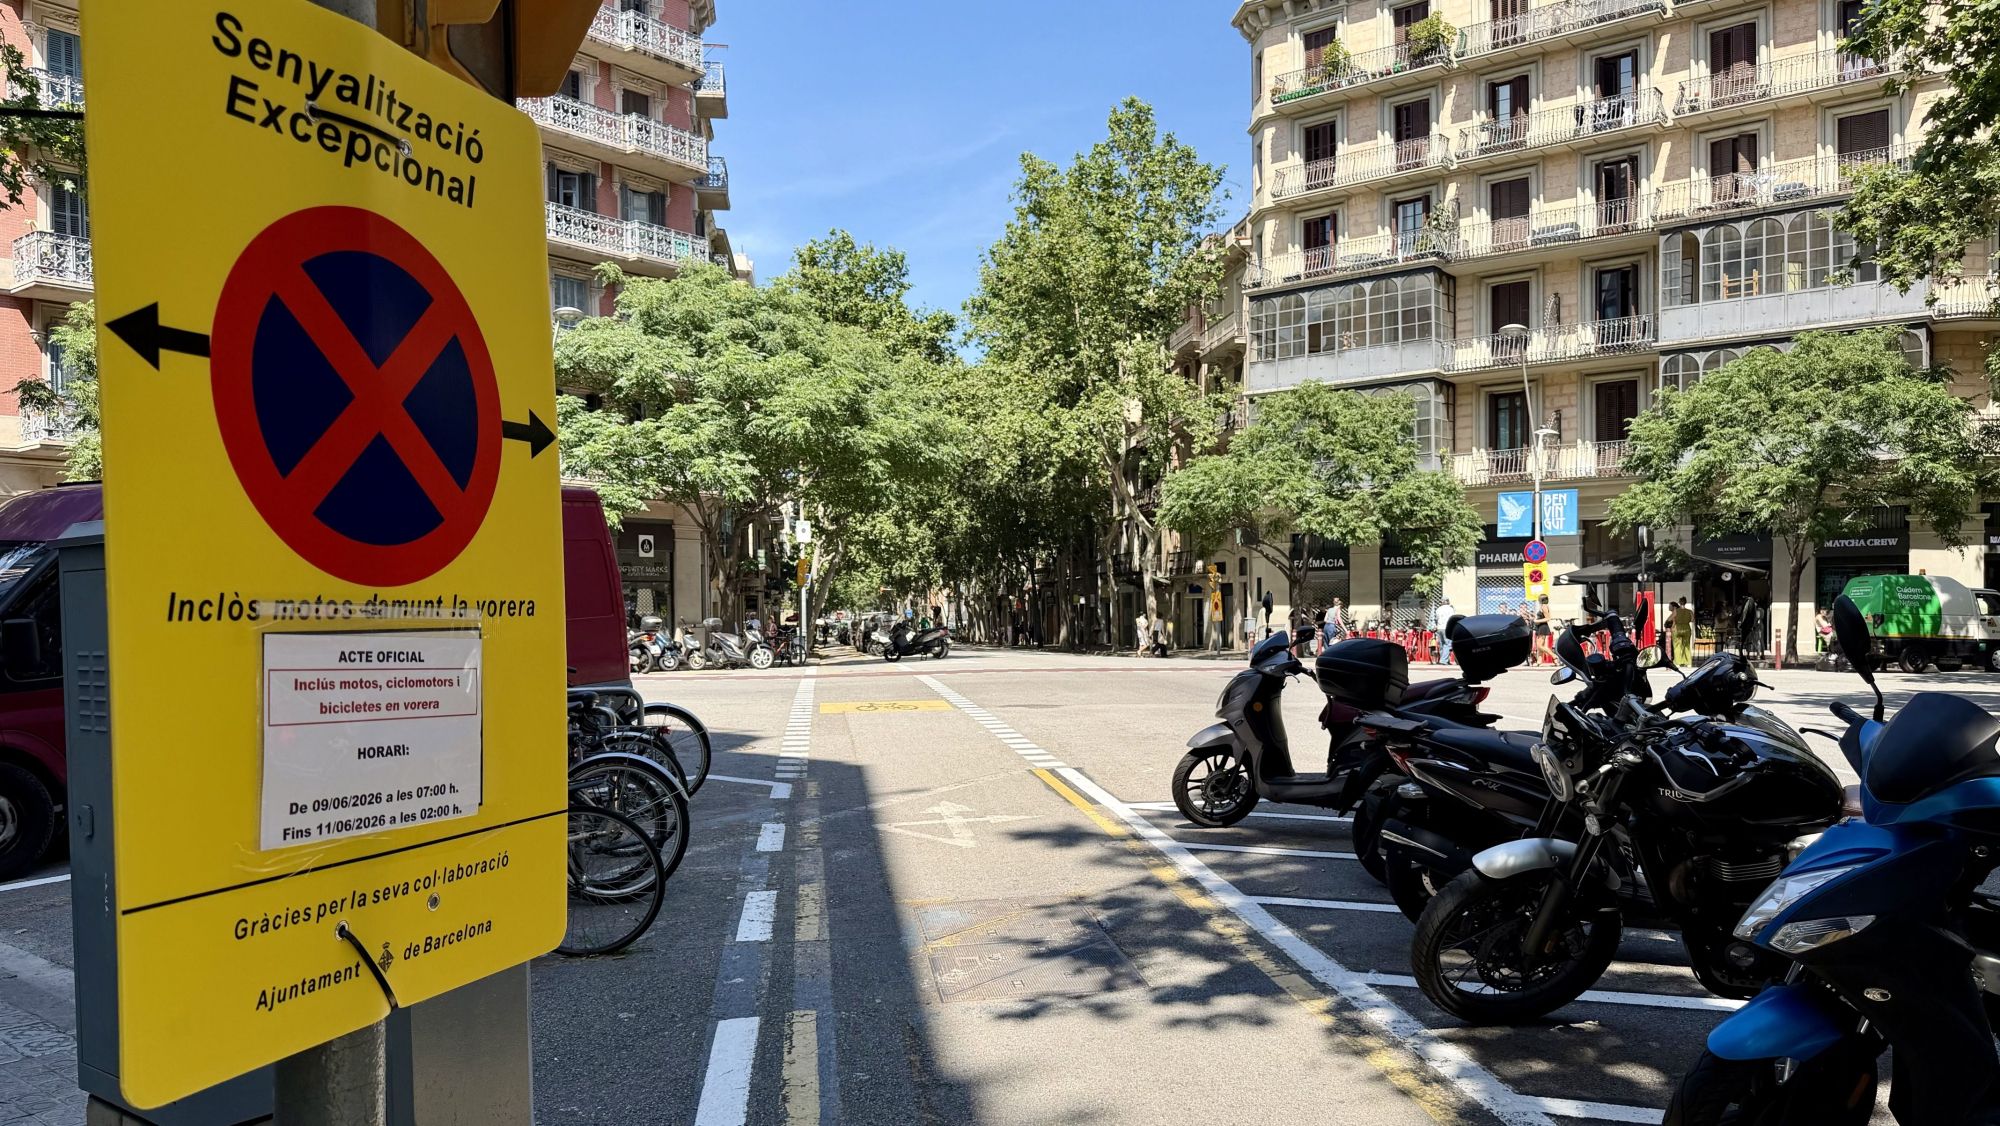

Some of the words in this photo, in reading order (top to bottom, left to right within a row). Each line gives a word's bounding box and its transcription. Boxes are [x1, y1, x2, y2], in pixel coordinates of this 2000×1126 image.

[212, 11, 483, 164] Senyalització
[226, 75, 476, 208] Excepcional
[1544, 493, 1567, 505] BEN
[1544, 505, 1564, 518] VIN
[1544, 518, 1566, 530] GUT
[1824, 538, 1866, 548] MATCHA
[1866, 537, 1899, 547] CREW
[1293, 557, 1345, 568] FAMÀCIA
[167, 592, 261, 622] Inclòs
[273, 594, 353, 620] motos
[451, 594, 468, 618] la
[476, 599, 535, 618] vorera
[338, 651, 373, 663] ACTE
[377, 650, 425, 662] OFICIAL
[294, 677, 336, 691] Inclús
[339, 678, 383, 691] motos,
[386, 677, 454, 688] ciclomotors
[456, 676, 460, 687] i
[319, 701, 382, 714] bicicletes
[385, 701, 400, 711] en
[403, 699, 440, 710] vorera
[357, 744, 410, 760] HORARI:
[289, 802, 308, 815] De
[312, 792, 382, 813] 09/06/2026
[385, 793, 393, 803] a
[396, 788, 413, 801] les
[416, 783, 446, 798] 07:00
[449, 783, 459, 794] h.
[282, 826, 312, 841] Fins
[316, 814, 386, 836] 11/06/2026
[389, 816, 397, 825] a
[400, 811, 417, 824] les
[420, 805, 450, 820] 02:00
[452, 804, 462, 815] h.
[234, 906, 312, 941] Gràcies
[316, 897, 347, 924] per
[350, 891, 367, 911] la
[372, 881, 409, 905] seva
[413, 850, 509, 893] col·laboració
[255, 960, 361, 1012] Ajuntament
[403, 942, 420, 961] de
[422, 918, 492, 954] Barcelona
